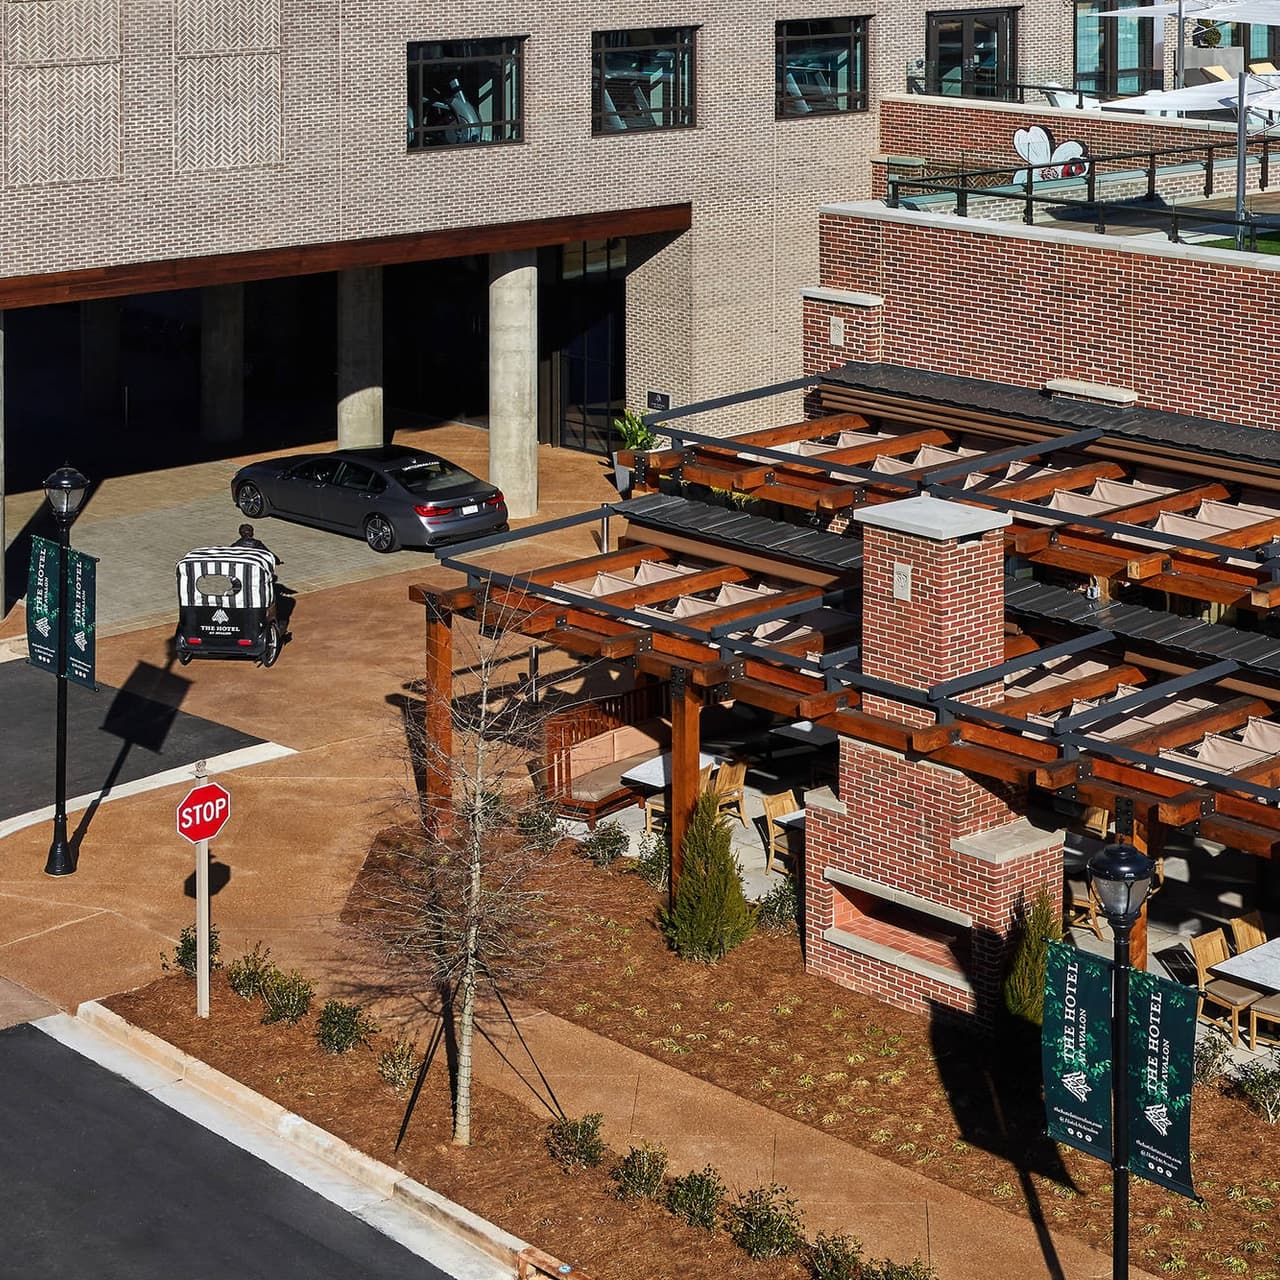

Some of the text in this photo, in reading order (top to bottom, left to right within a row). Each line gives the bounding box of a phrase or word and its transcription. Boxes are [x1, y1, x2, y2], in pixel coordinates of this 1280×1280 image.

[36, 548, 47, 614] THE HOTEL
[181, 797, 226, 829] STOP
[1063, 962, 1079, 1064] THE HOTEL
[1078, 1008, 1088, 1068] AT AVALON
[1147, 992, 1163, 1095] THE HOTEL
[1160, 1038, 1170, 1099] AT AVALON
